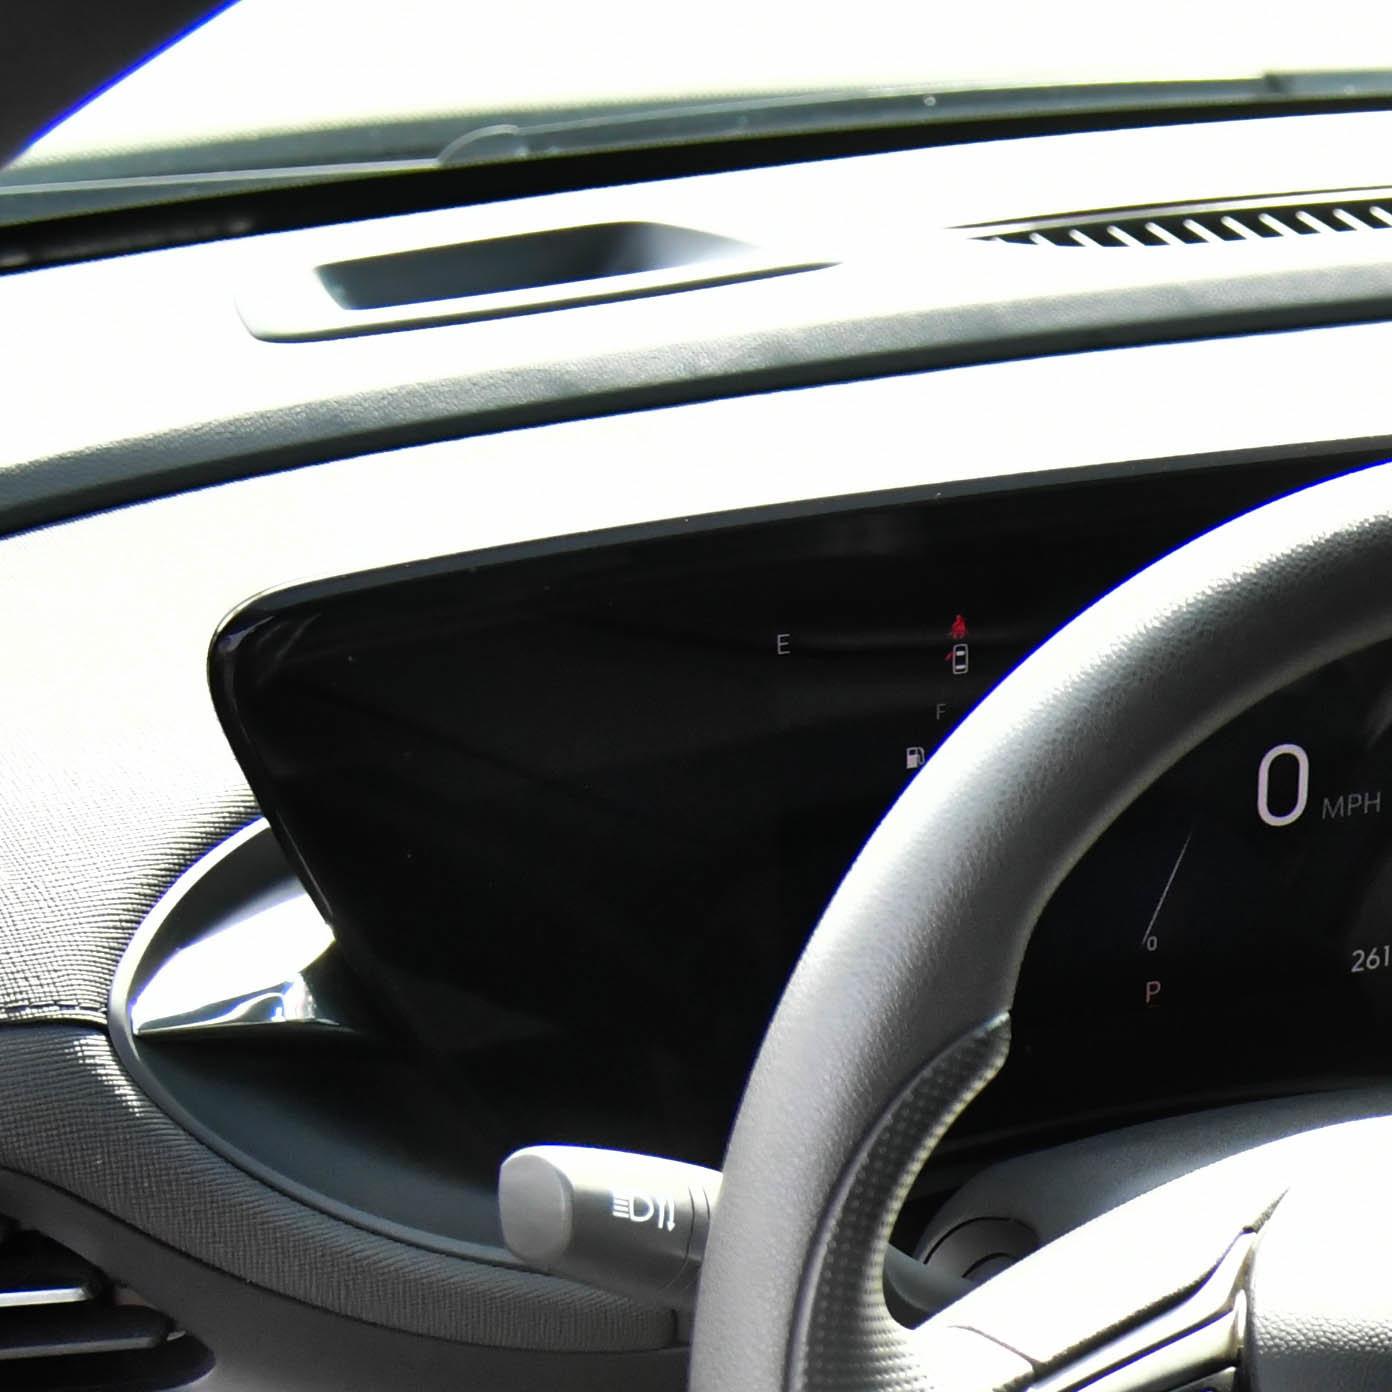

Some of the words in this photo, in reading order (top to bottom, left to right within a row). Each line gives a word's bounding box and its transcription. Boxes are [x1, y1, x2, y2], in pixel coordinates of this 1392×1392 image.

[777, 633, 791, 655] E
[936, 703, 946, 720] F
[1257, 743, 1310, 827] 0
[1321, 791, 1382, 820] MPH
[1146, 980, 1161, 1004] P
